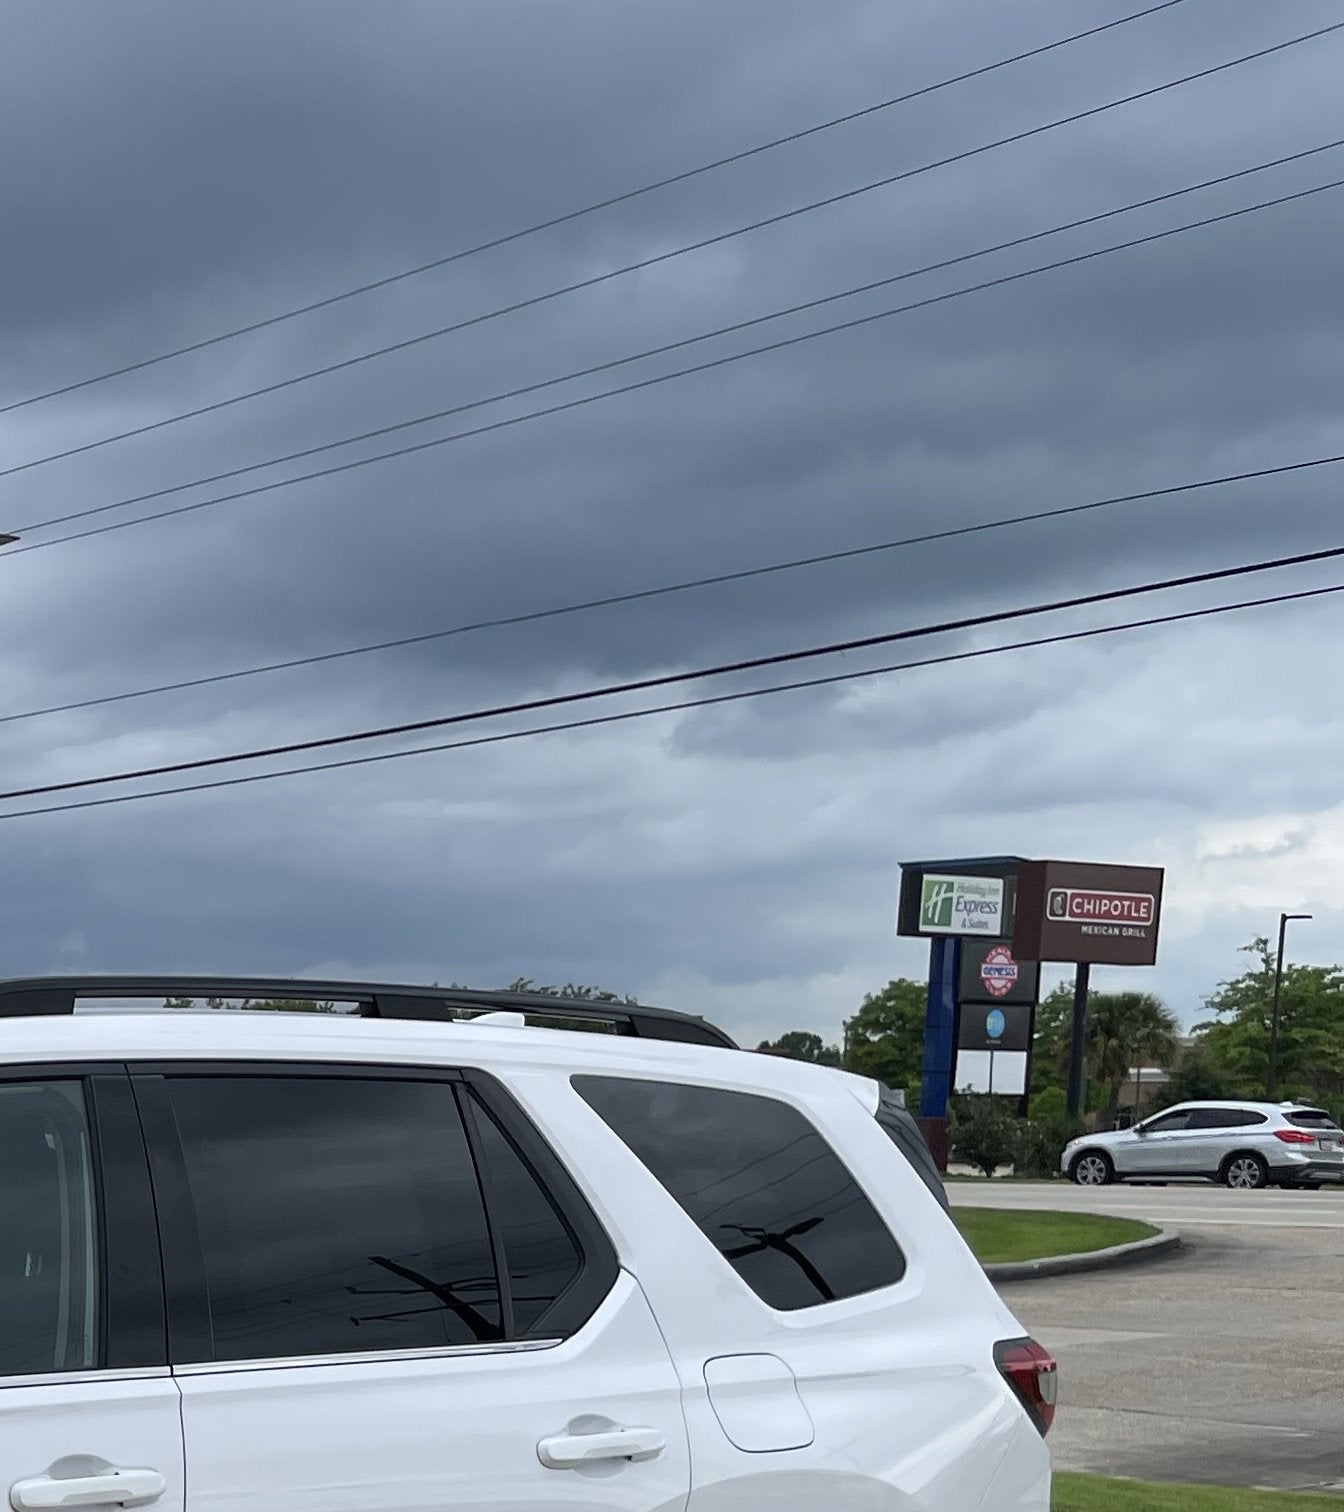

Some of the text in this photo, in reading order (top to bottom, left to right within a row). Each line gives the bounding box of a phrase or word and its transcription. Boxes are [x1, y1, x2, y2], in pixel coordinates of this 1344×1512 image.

[955, 896, 999, 916] Express
[1072, 898, 1149, 918] CHIPOTLE
[1080, 925, 1146, 938] MEXICAN GRILL
[983, 966, 1016, 976] GENESIS
